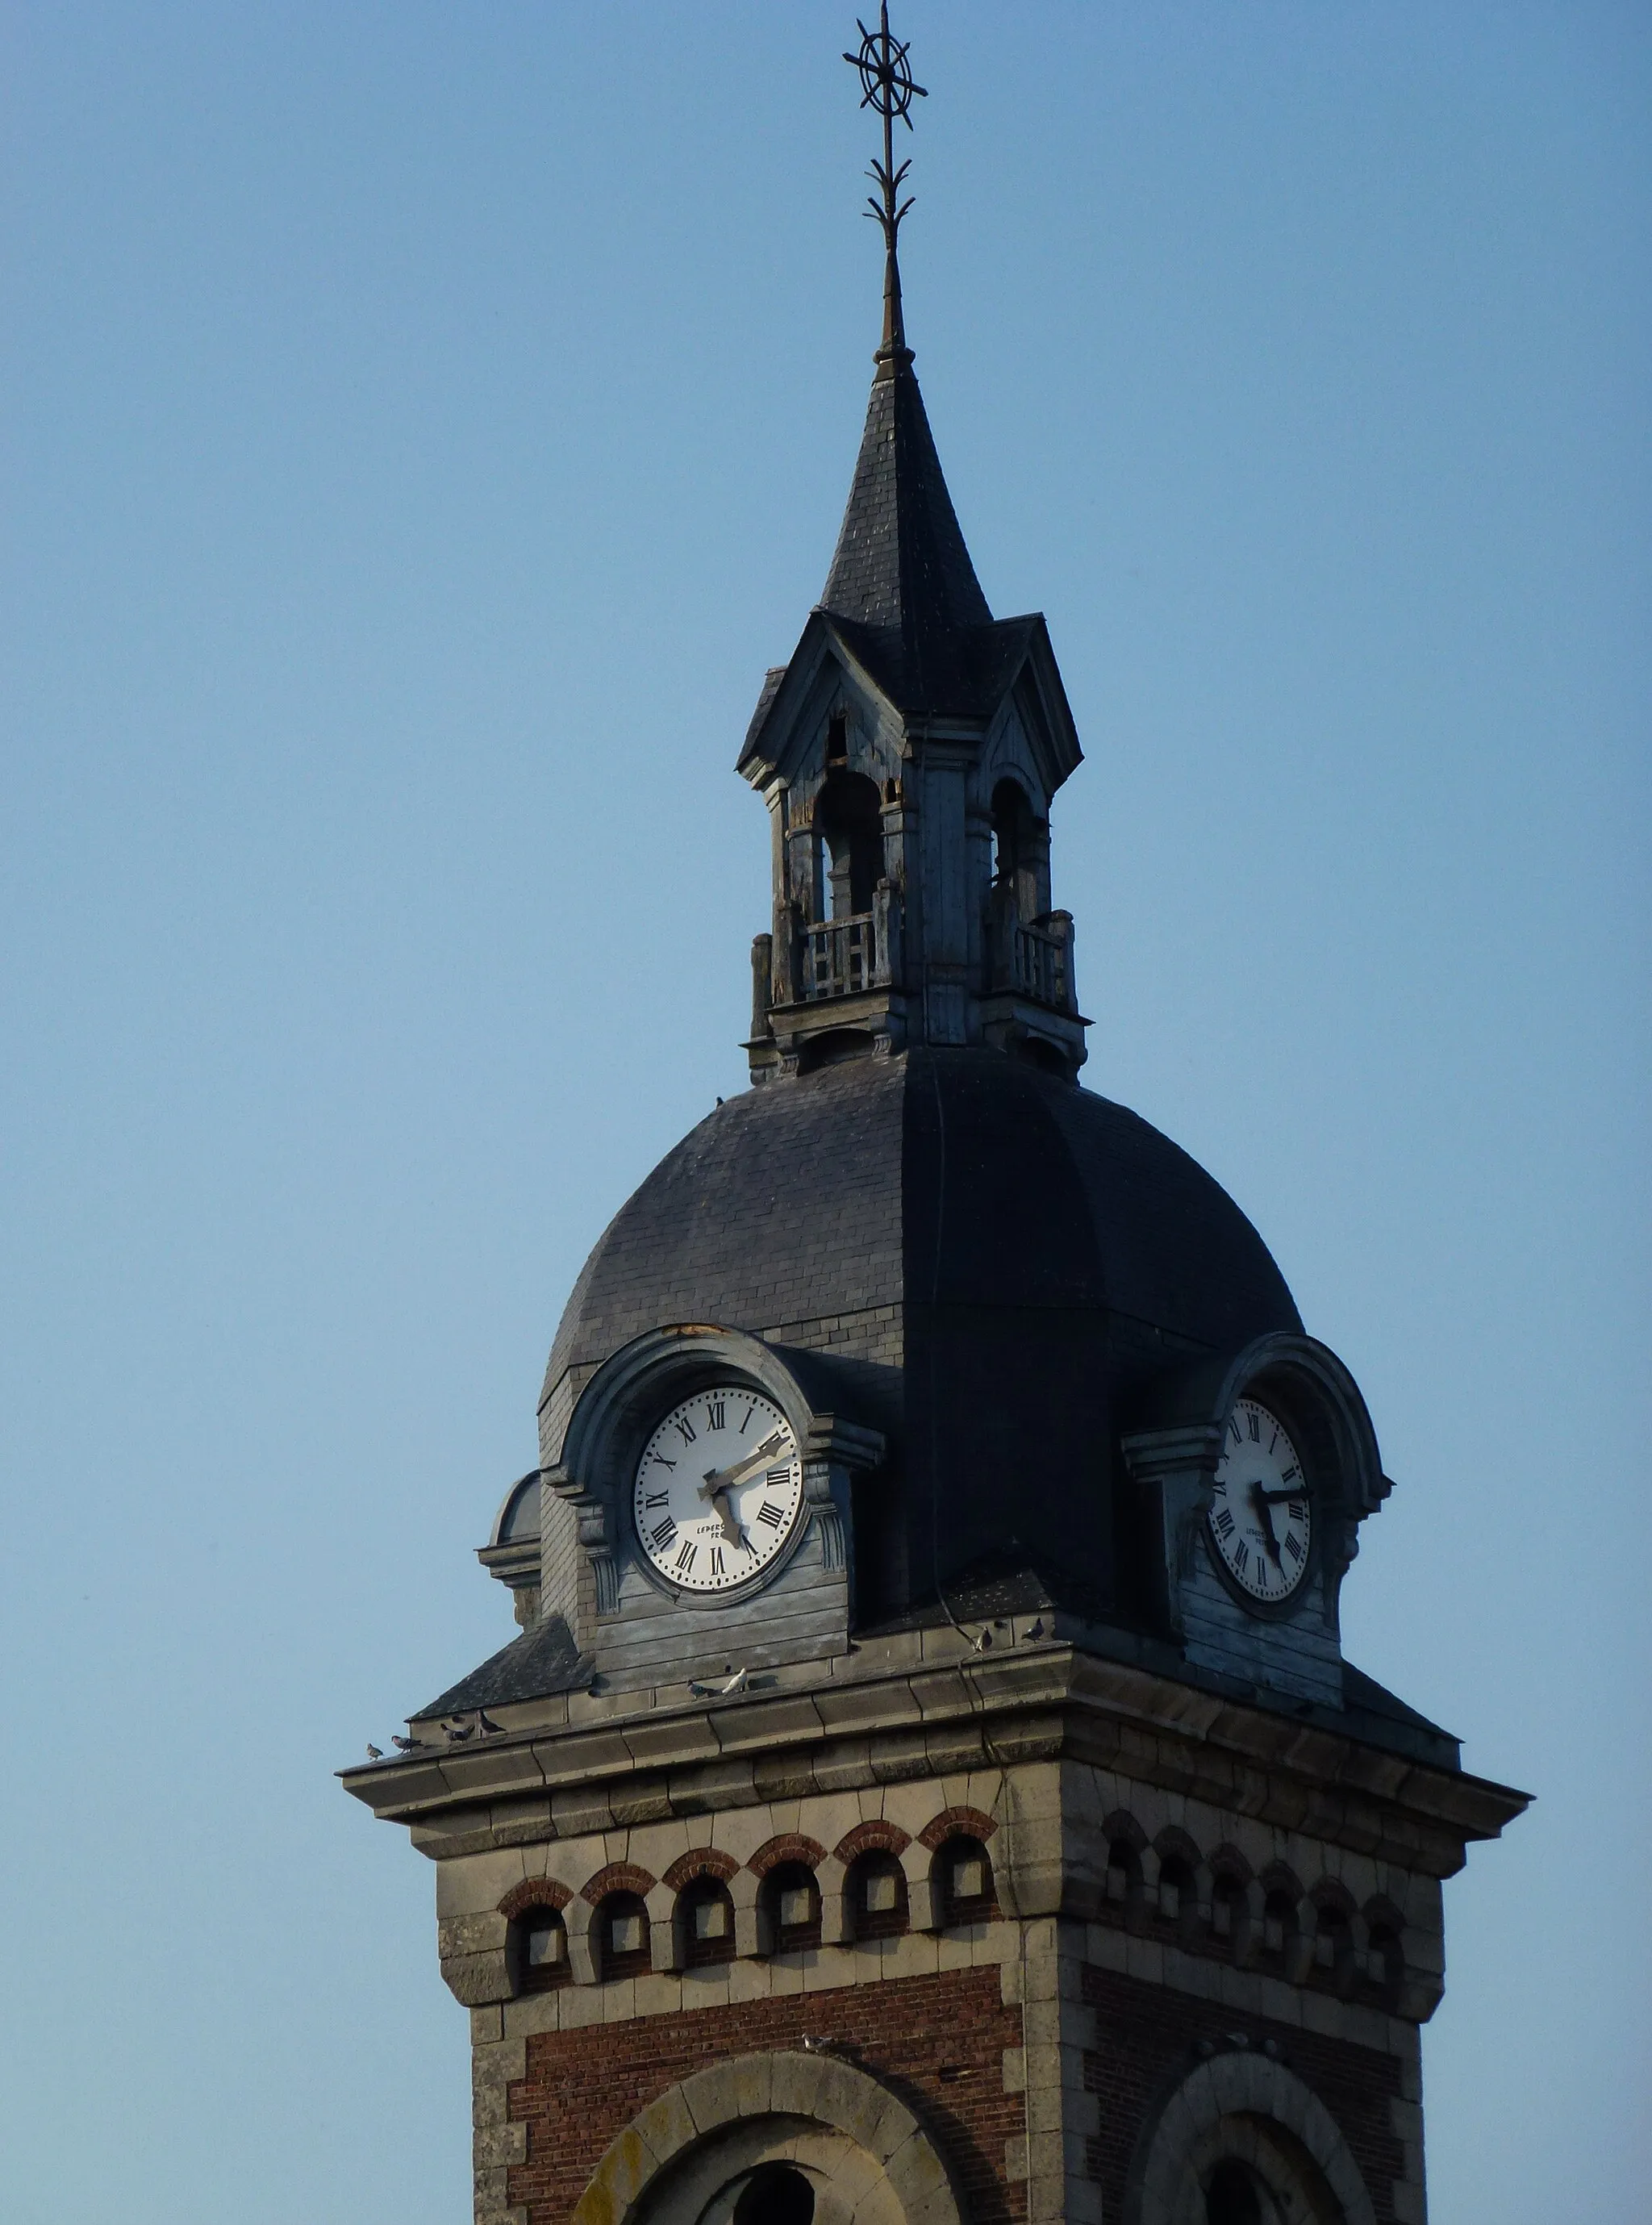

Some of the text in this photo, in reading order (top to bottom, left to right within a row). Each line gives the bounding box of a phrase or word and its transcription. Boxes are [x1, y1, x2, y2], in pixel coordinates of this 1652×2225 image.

[707, 1401, 726, 1432] XII
[739, 1407, 754, 1434] I
[674, 1417, 697, 1447] XI
[1269, 1432, 1278, 1455] I
[653, 1452, 678, 1472] X
[1282, 1466, 1295, 1483] II
[766, 1467, 791, 1488] III
[645, 1489, 670, 1510] IX
[756, 1501, 785, 1530] IIII
[650, 1515, 679, 1553] VIII
[674, 1539, 699, 1575] VII
[710, 1546, 726, 1576] VI
